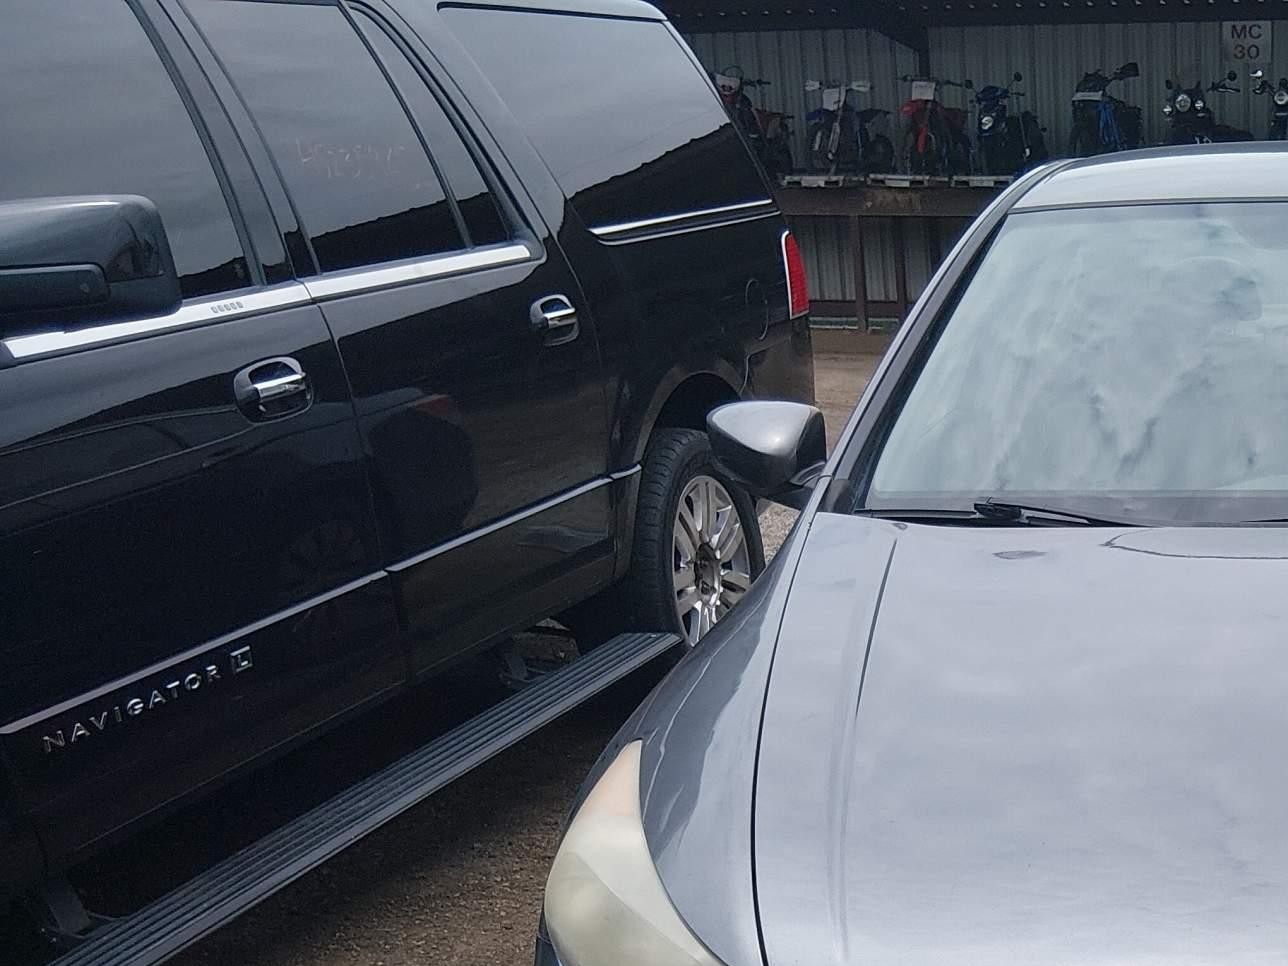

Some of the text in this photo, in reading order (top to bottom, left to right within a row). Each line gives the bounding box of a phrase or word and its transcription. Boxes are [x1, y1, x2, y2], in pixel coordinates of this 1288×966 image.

[1231, 23, 1263, 40] MC
[1233, 44, 1260, 60] 30
[42, 663, 222, 753] NAVIGATOR
